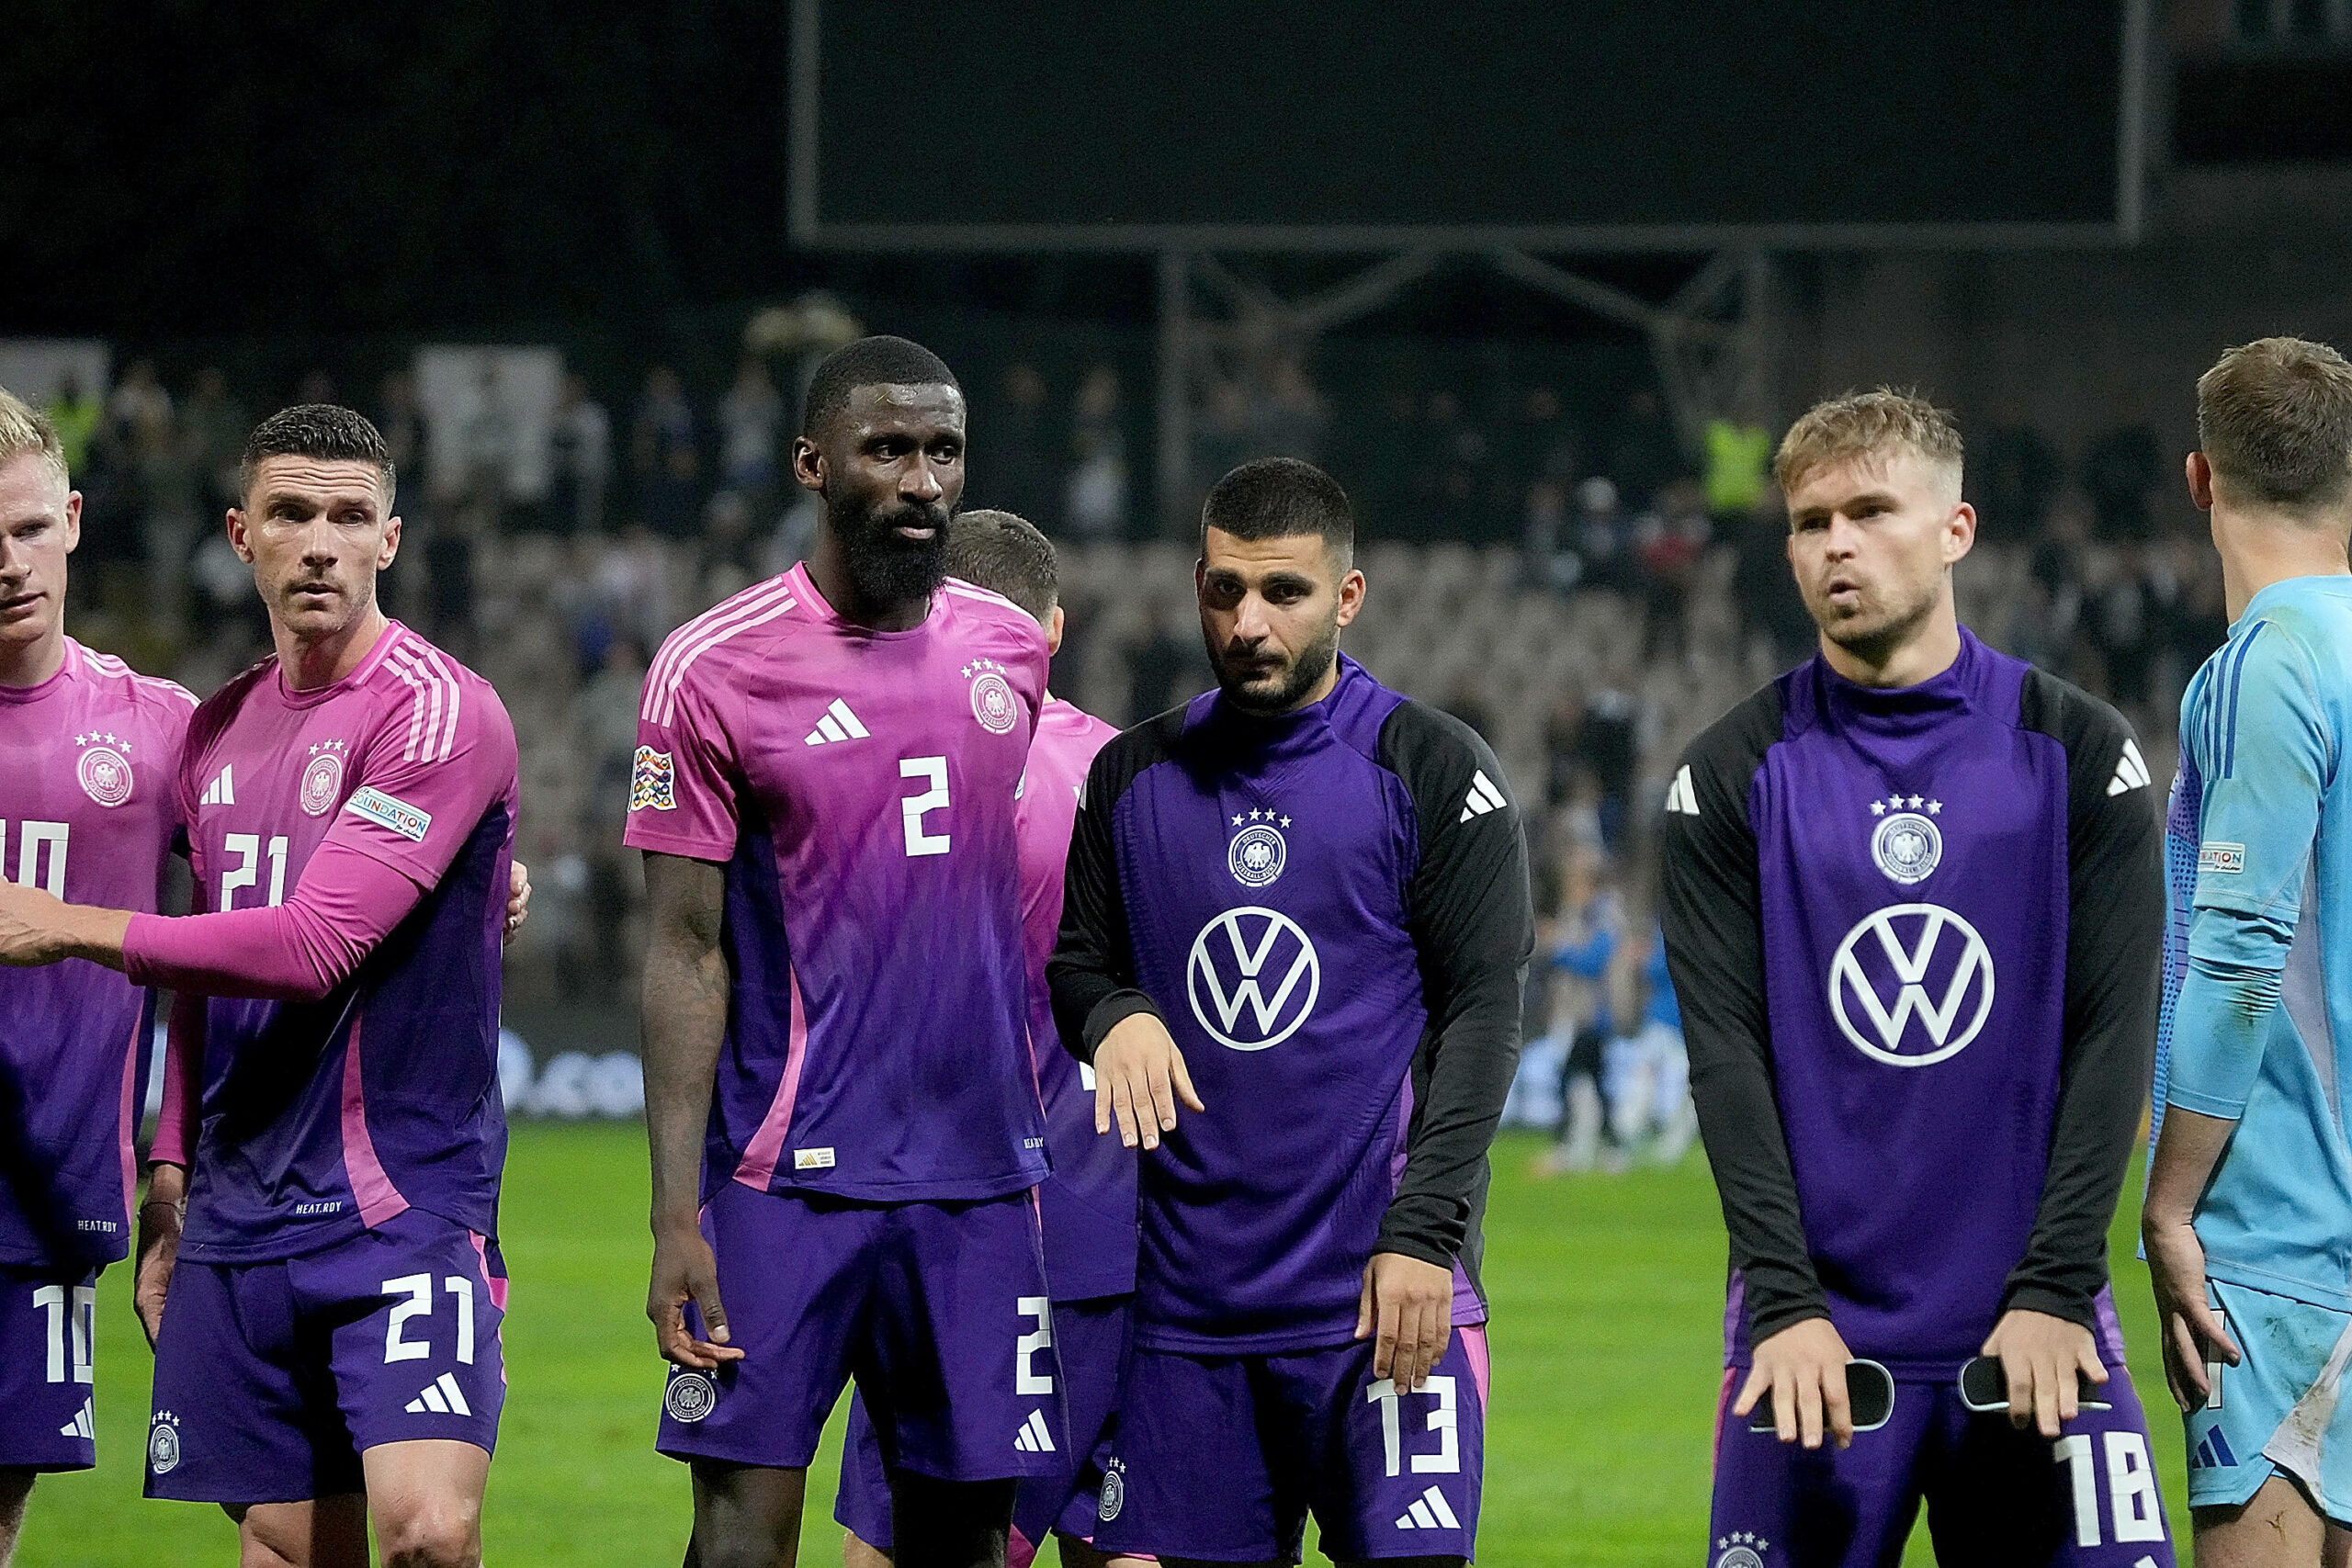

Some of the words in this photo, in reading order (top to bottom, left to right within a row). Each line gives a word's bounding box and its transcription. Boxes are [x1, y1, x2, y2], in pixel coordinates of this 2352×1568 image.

[352, 793, 426, 832] FOUNDATION
[899, 756, 950, 856] 2
[1242, 832, 1276, 845] DEUTSCHER
[0, 819, 69, 902] 0
[220, 833, 288, 913] 21
[1188, 907, 1319, 1051] VW
[1830, 905, 1994, 1066] VW
[296, 1201, 342, 1214] HEAT.RDY
[33, 1285, 96, 1384] 10
[381, 1273, 474, 1365] 21
[1016, 1296, 1052, 1395] 2
[1366, 1376, 1461, 1477] 13
[2054, 1431, 2166, 1548] 18
